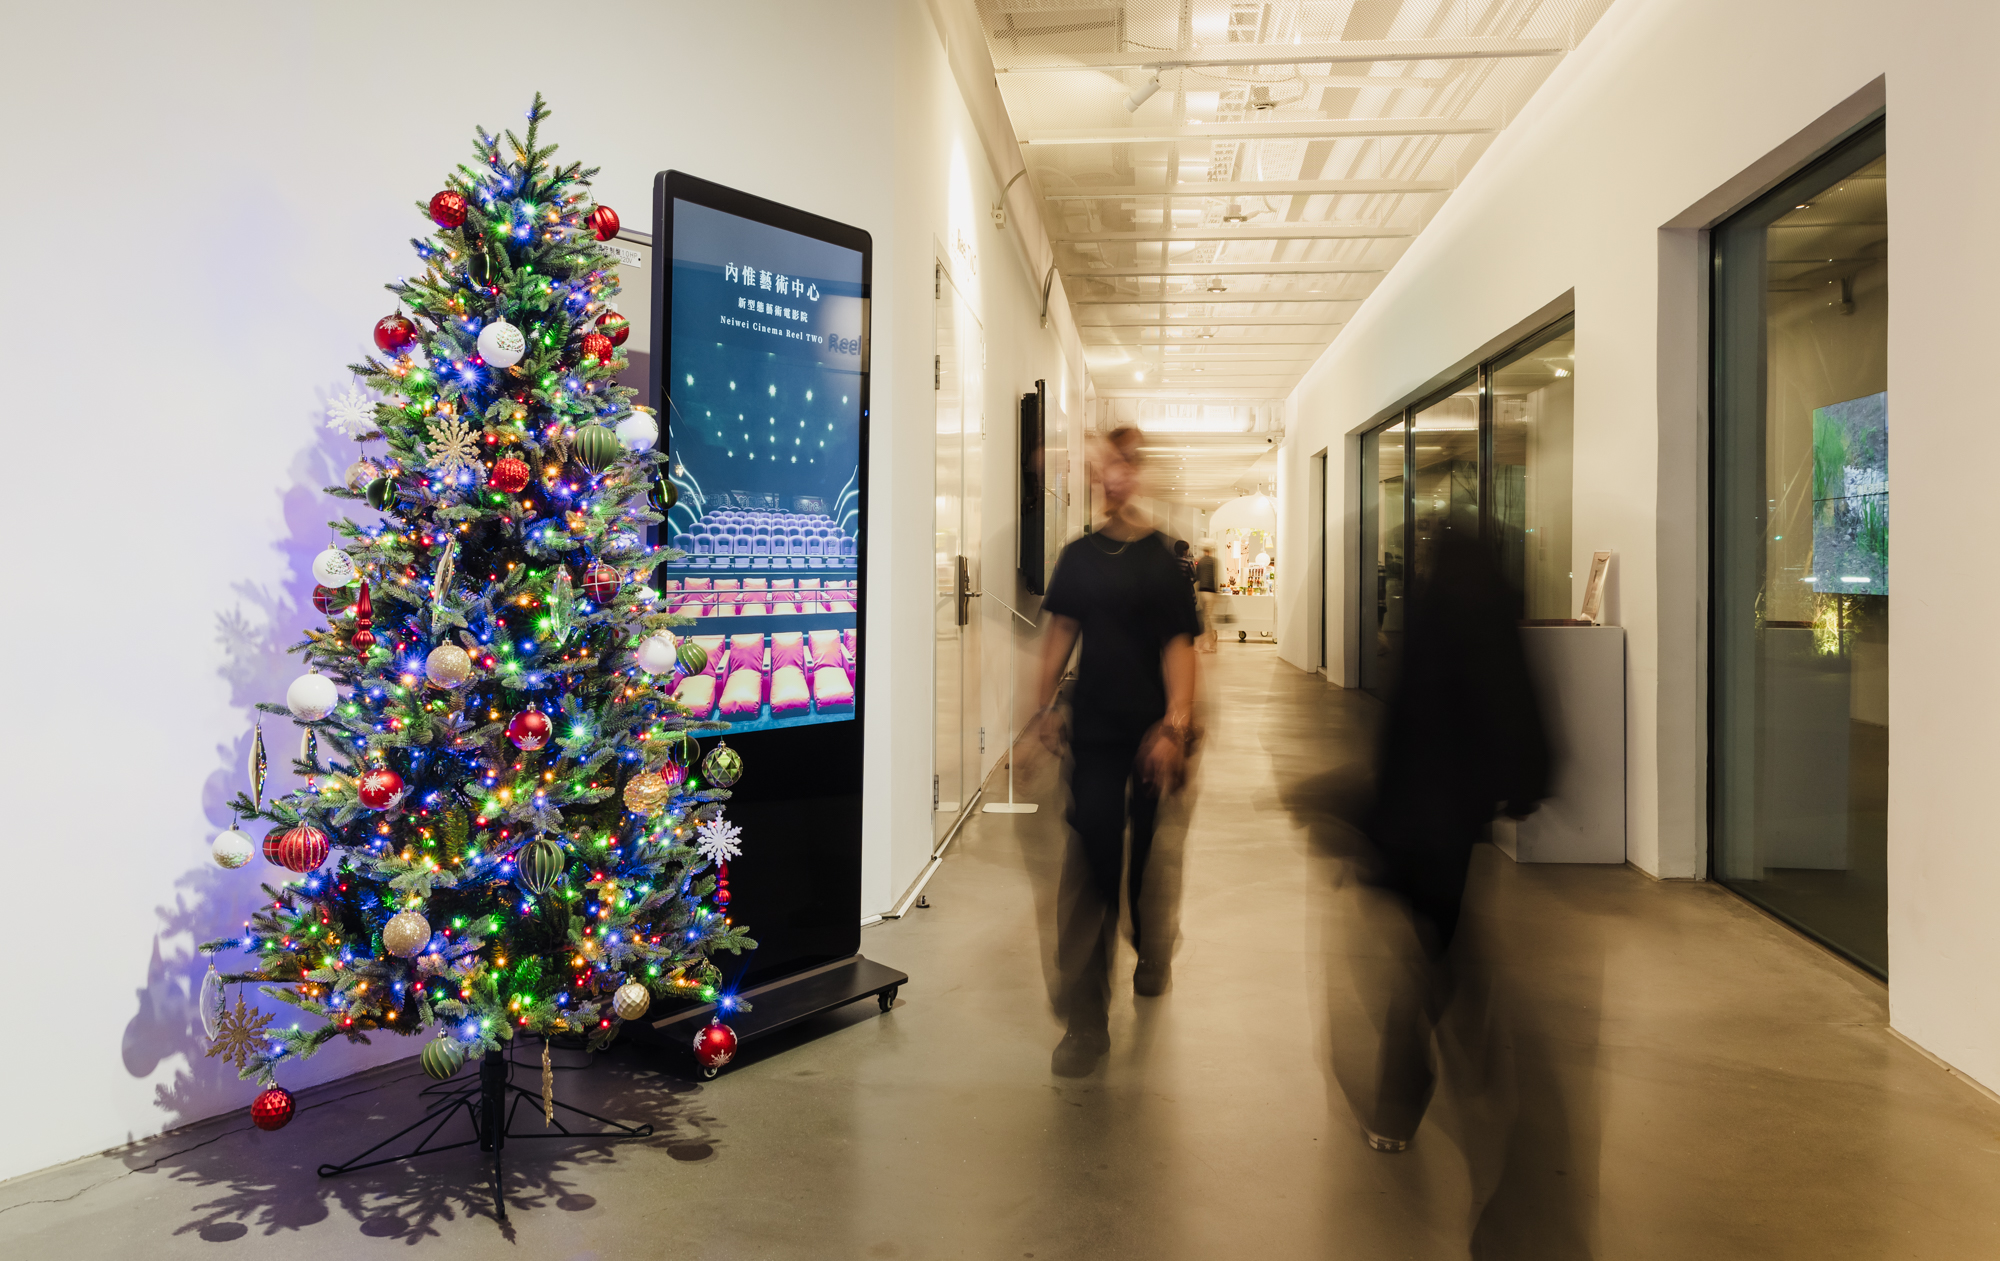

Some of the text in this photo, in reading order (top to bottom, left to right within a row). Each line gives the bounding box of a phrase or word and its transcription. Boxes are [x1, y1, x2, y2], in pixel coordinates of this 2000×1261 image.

[725, 262, 820, 302] 內惟藝術中心
[738, 297, 808, 323] 新型態藝術電影院
[720, 315, 823, 344] Neiwei Cinema Reel TWO
[828, 333, 862, 355] Reel
